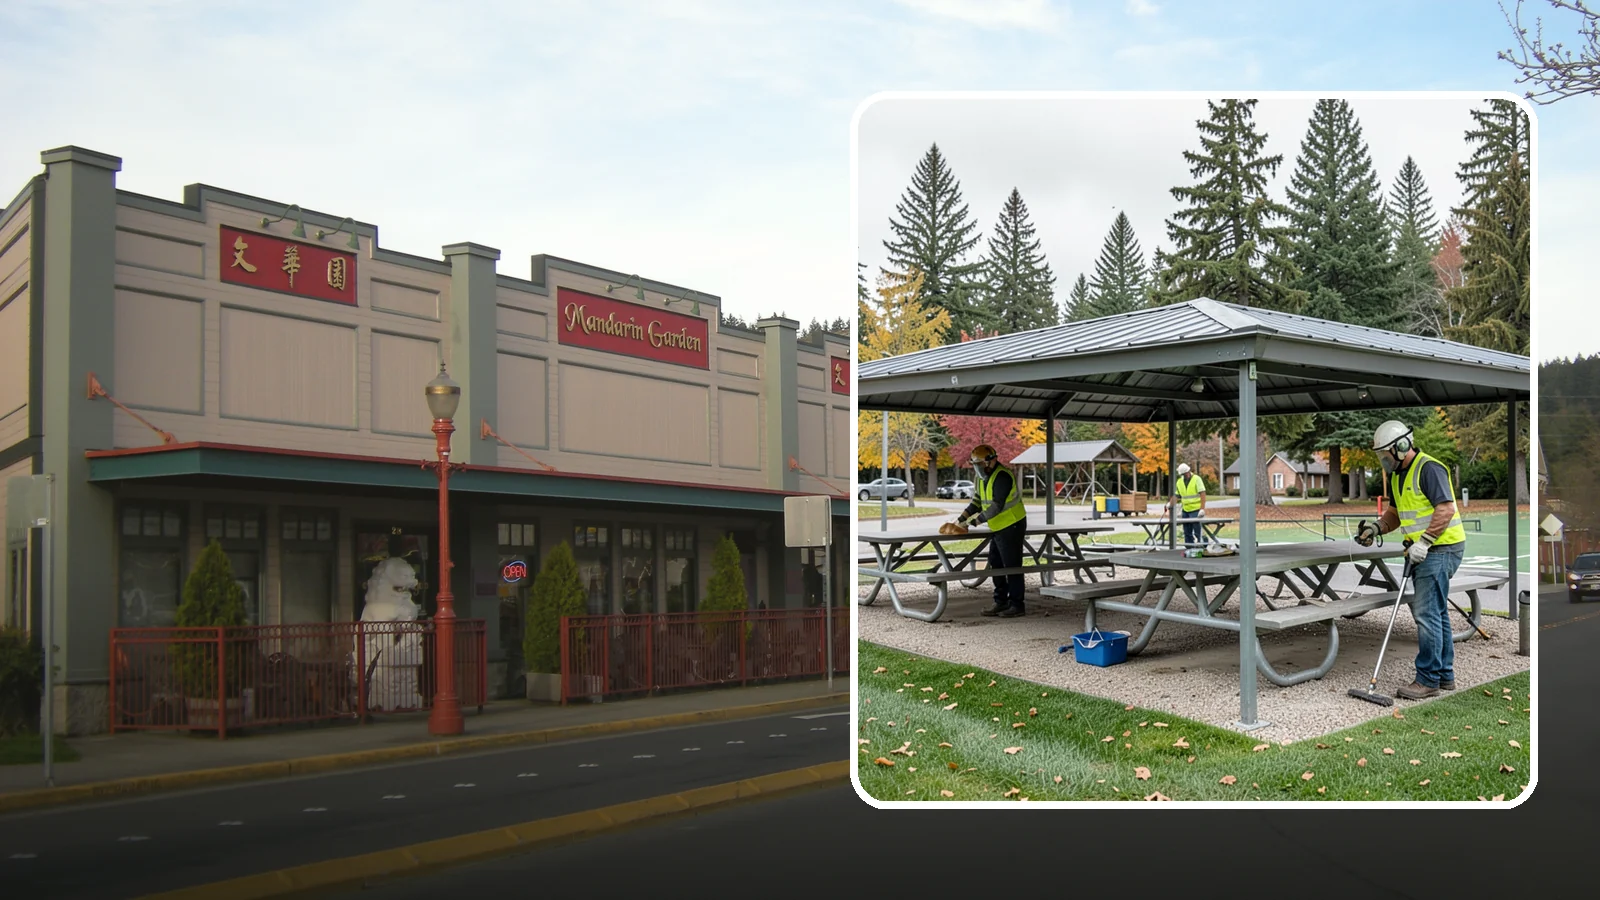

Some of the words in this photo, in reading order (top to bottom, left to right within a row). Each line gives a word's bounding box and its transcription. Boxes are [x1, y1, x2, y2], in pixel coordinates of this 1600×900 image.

[230, 235, 347, 291] 文華園
[564, 302, 644, 341] Mandarin
[648, 320, 702, 352] Garden
[503, 565, 527, 578] OPEN
